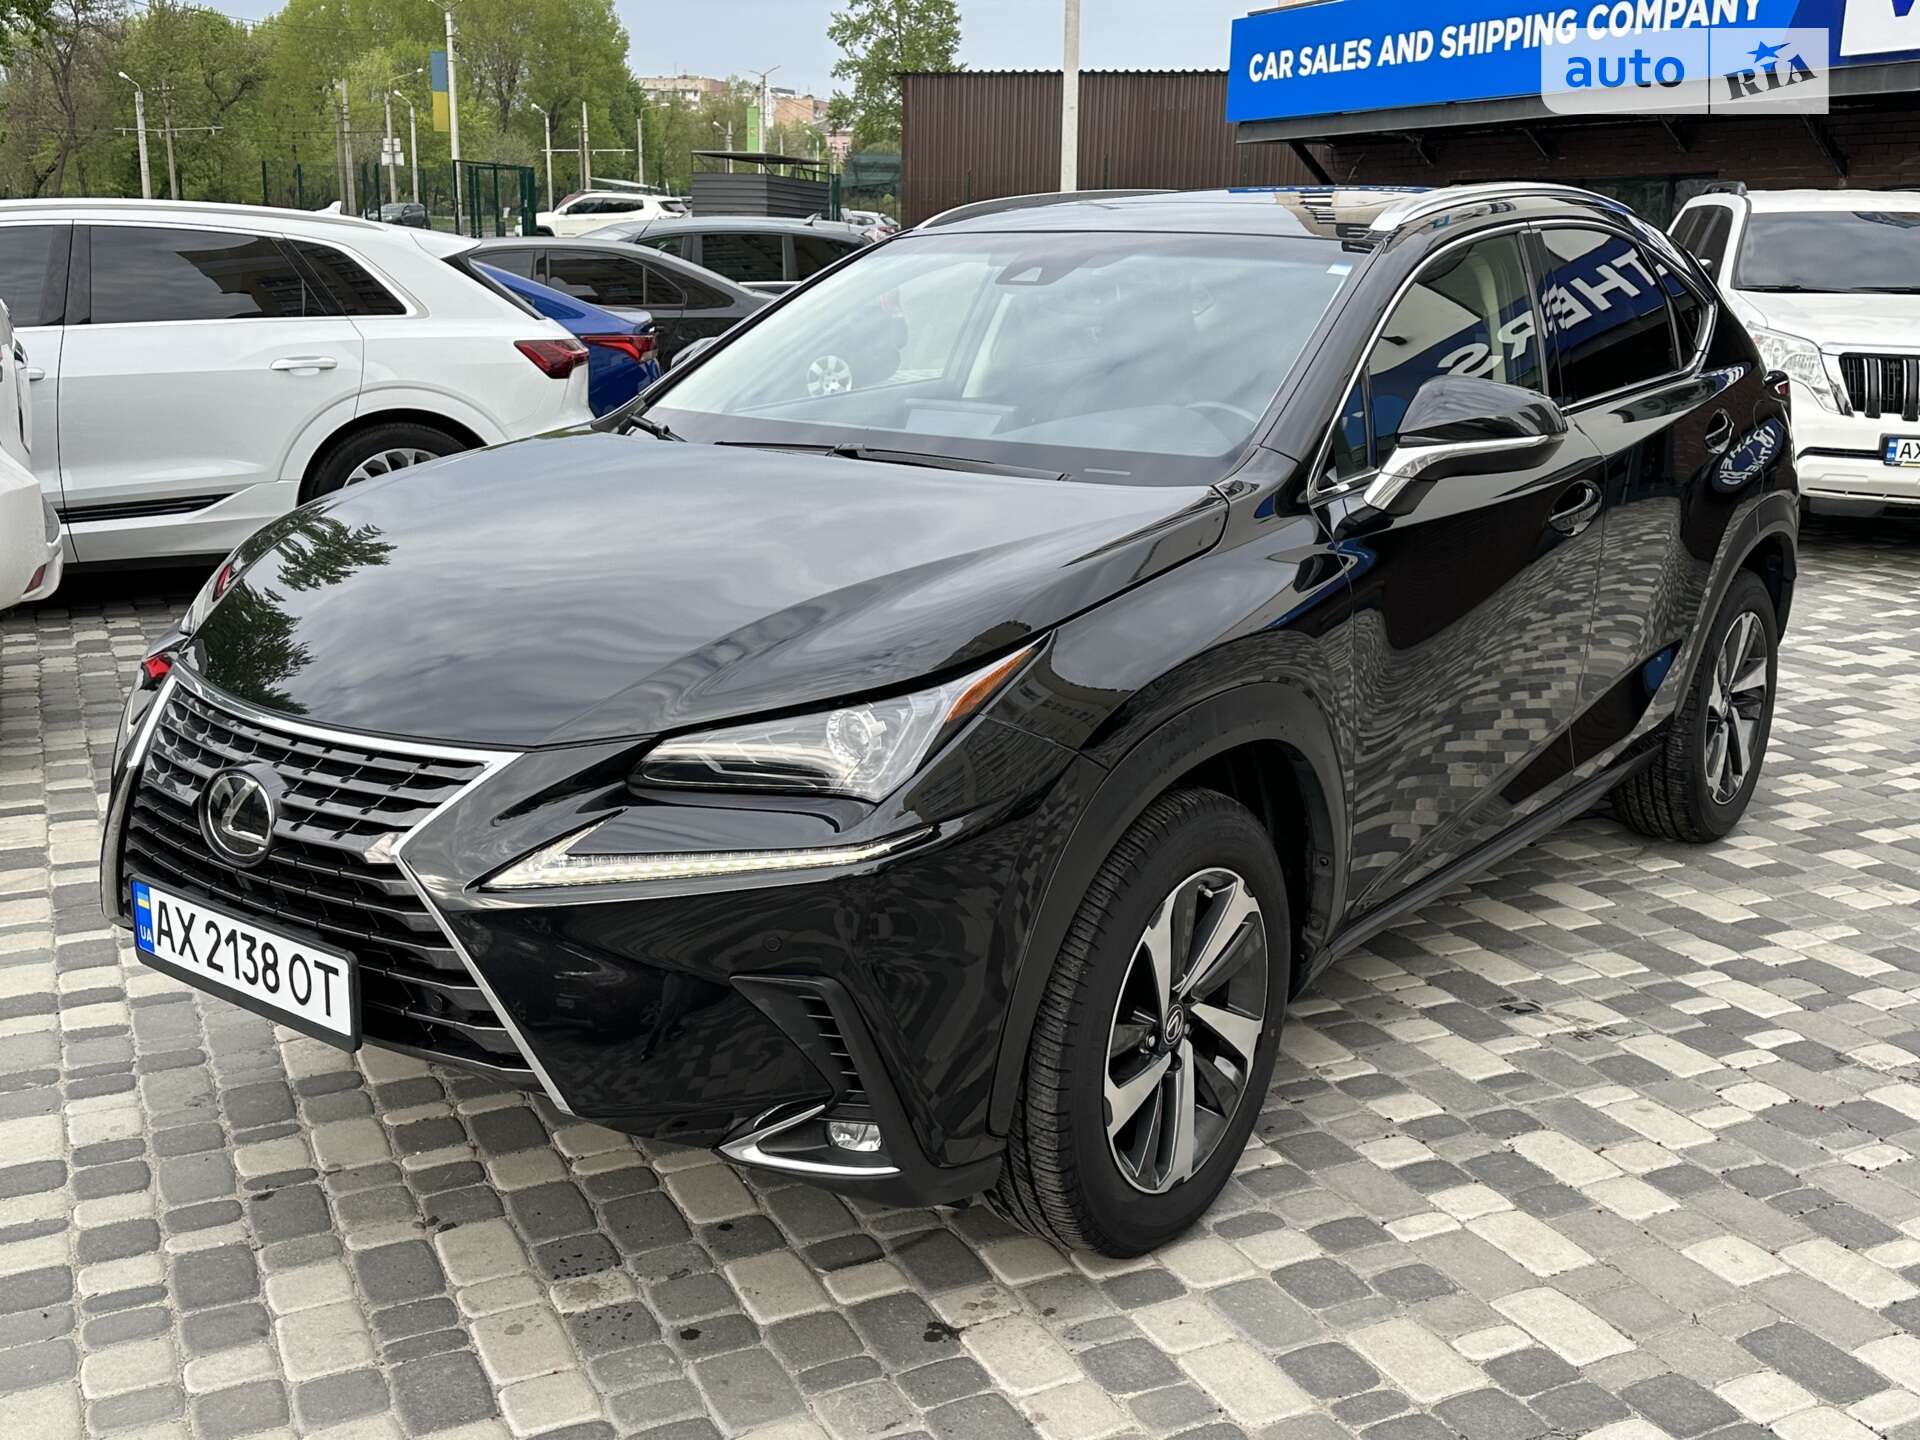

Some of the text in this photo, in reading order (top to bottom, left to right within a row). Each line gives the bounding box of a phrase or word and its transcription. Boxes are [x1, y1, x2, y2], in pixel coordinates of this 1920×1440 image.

[1249, 0, 1761, 83] CAR SALES AND SHIPPING COMPANY
[140, 924, 153, 944] UA
[157, 901, 339, 1017] AX 2138 OT
